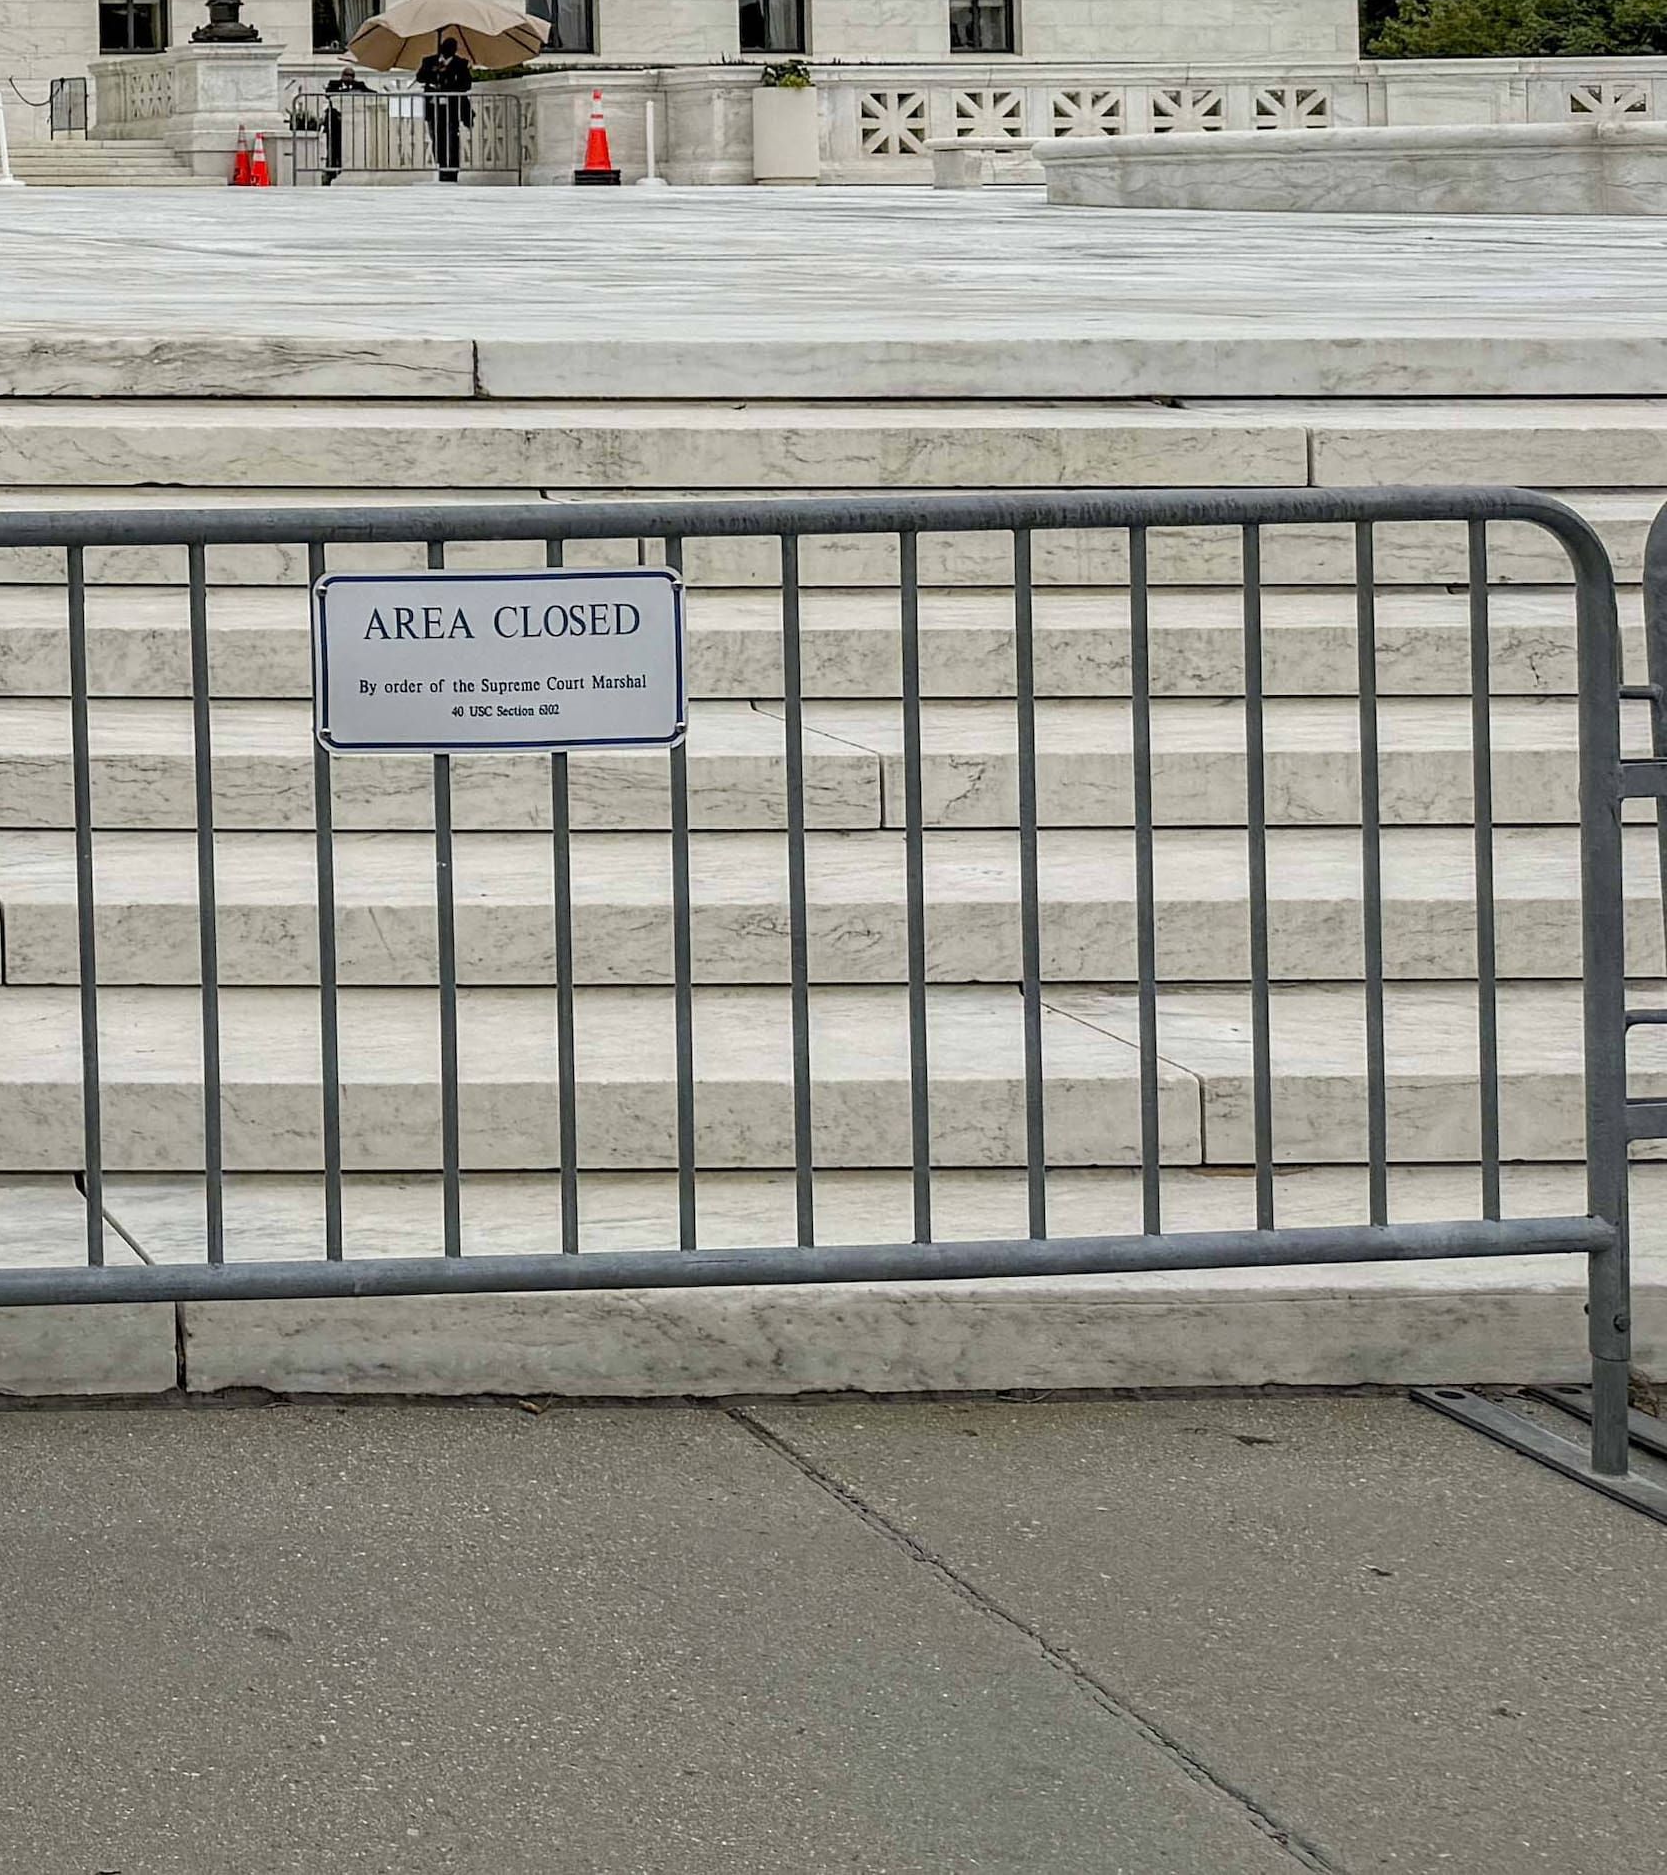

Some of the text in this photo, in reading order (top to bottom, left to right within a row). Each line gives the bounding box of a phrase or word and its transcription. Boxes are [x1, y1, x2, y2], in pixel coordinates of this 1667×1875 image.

[363, 603, 641, 640] AREA CLOSED
[359, 674, 647, 696] By order of the Supreme Court Marshal
[451, 706, 464, 717] 40
[470, 705, 493, 717] USC
[497, 704, 535, 717] Section
